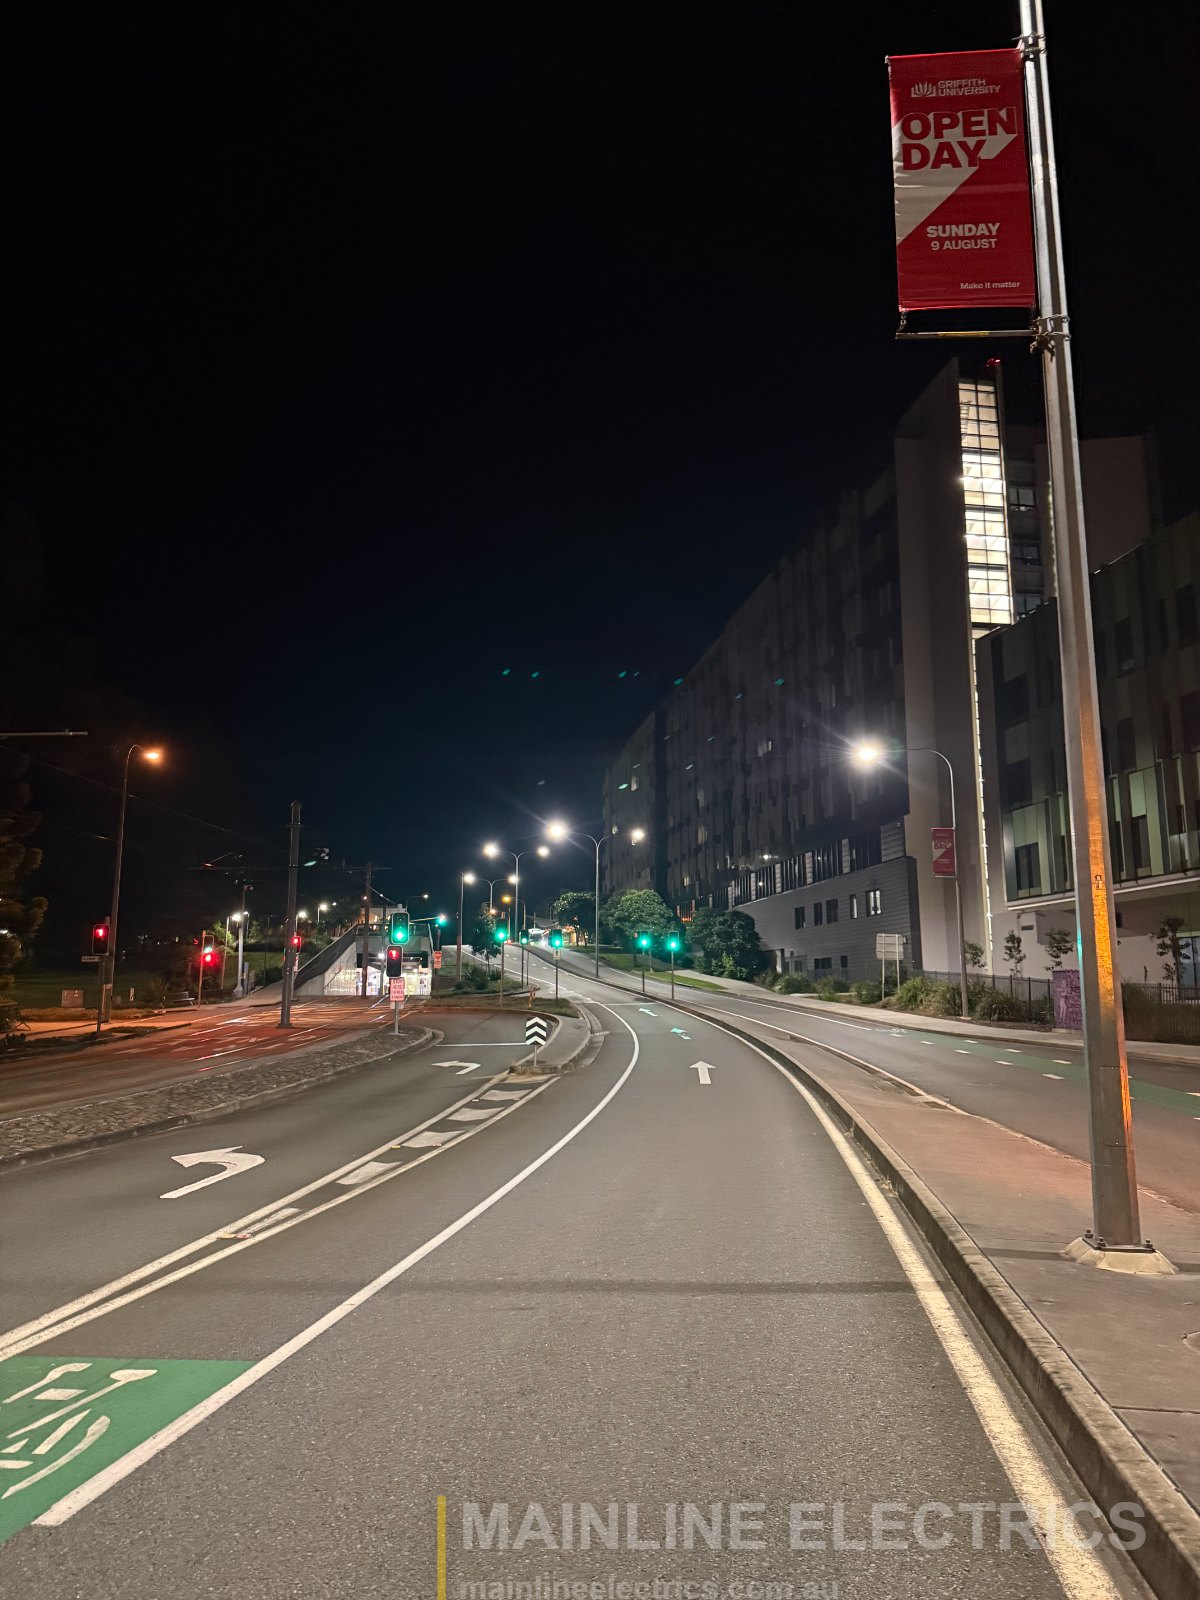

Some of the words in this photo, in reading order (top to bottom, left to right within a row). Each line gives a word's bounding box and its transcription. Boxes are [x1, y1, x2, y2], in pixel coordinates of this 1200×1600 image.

[938, 79, 986, 88] GRIFFITH
[938, 85, 1001, 97] UNIVERSITY
[901, 107, 1016, 140] OPEN
[902, 139, 987, 171] DAY
[926, 222, 1001, 238] SUNDAY
[930, 240, 940, 251] 9
[942, 238, 998, 250] AUGUST
[960, 282, 983, 290] Make
[984, 281, 991, 289] it
[992, 281, 1021, 289] matter
